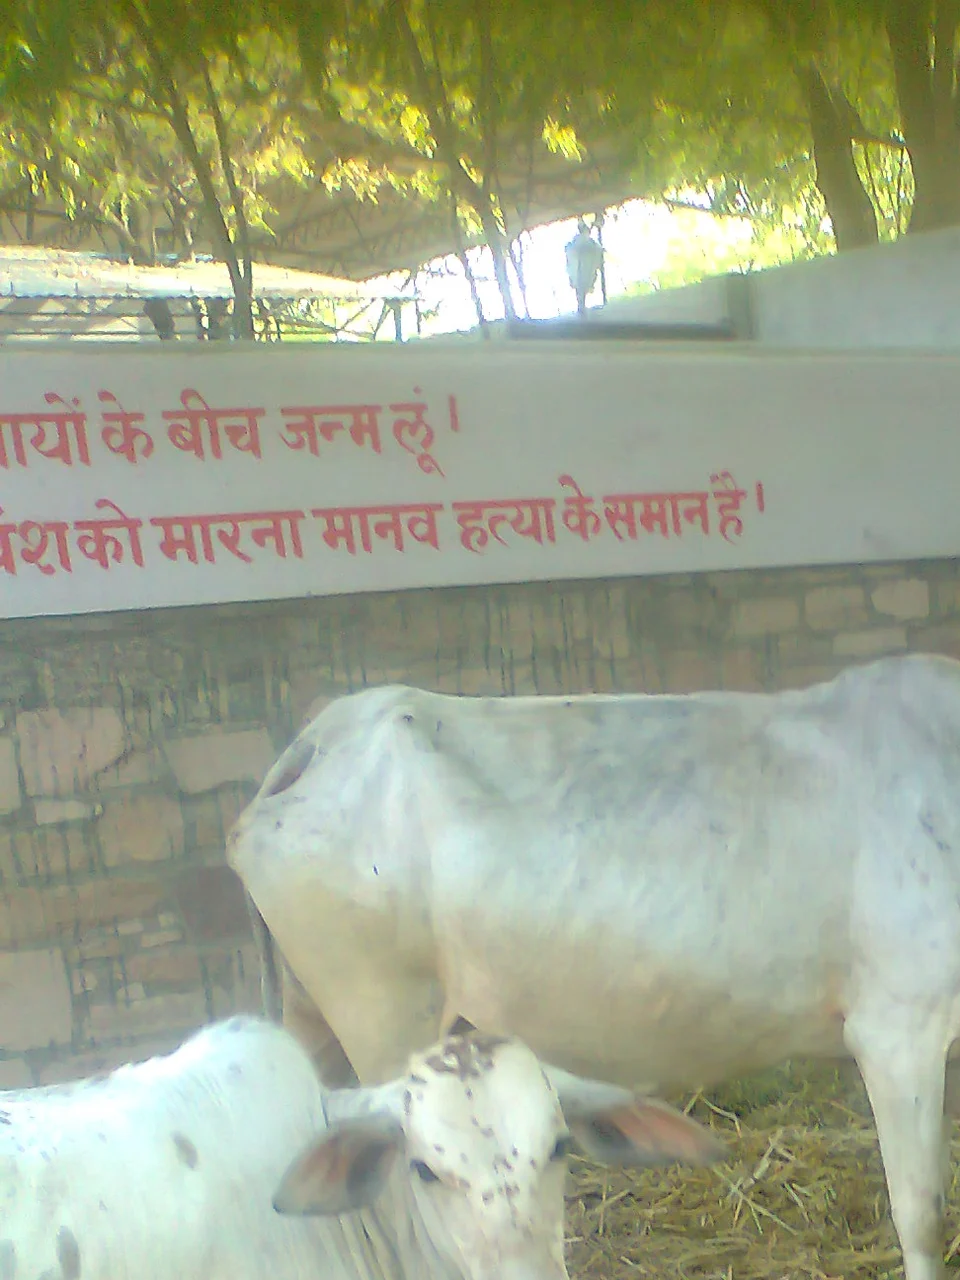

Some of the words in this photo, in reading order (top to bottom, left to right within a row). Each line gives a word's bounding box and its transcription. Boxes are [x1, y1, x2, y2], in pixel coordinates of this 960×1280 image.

[97, 389, 154, 464] के
[162, 389, 265, 460] बीच
[280, 404, 383, 457] जन्म
[74, 498, 145, 570] को
[149, 510, 305, 564] मारना
[311, 503, 444, 555] मानव
[452, 497, 557, 554] हत्या
[557, 474, 602, 542] के
[601, 491, 710, 542] समान
